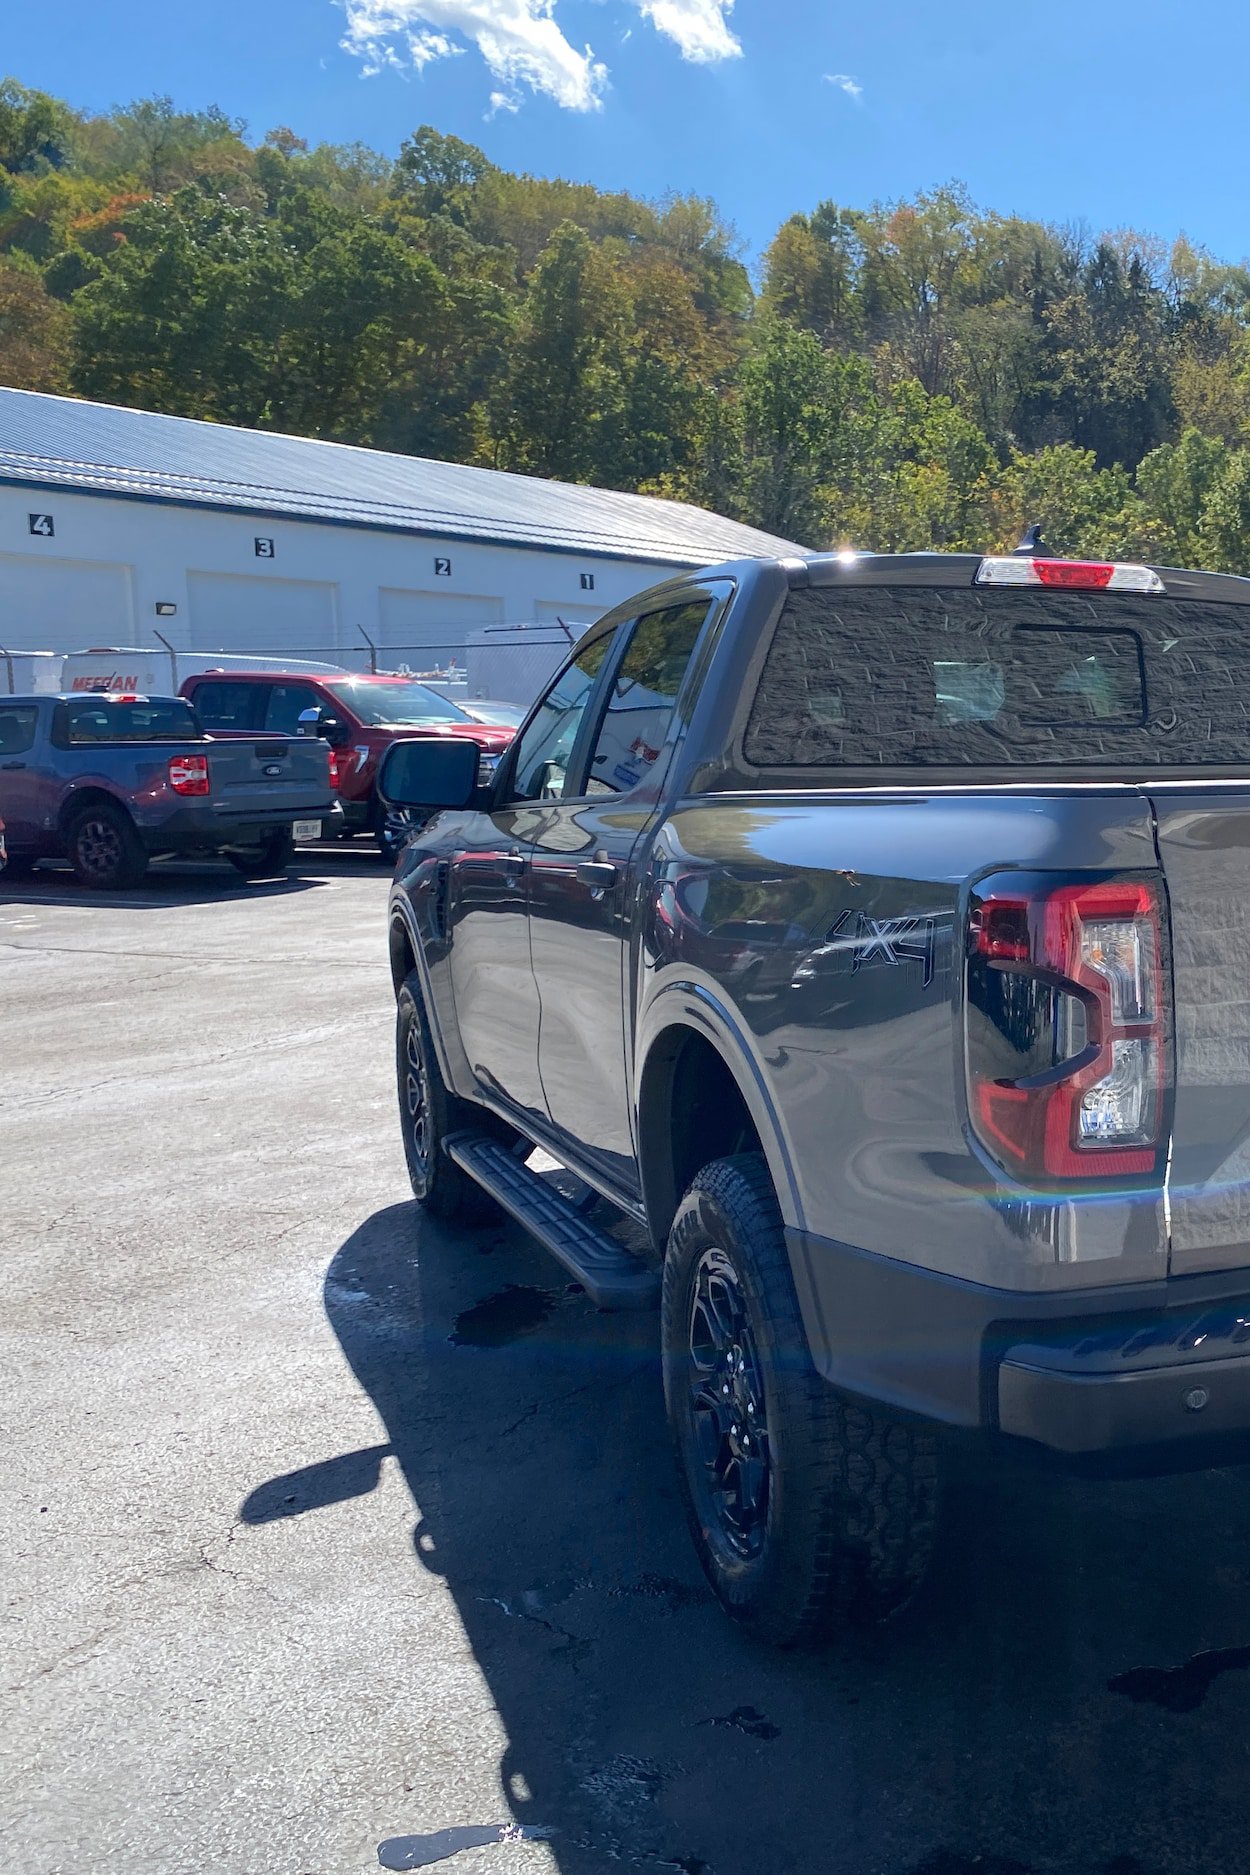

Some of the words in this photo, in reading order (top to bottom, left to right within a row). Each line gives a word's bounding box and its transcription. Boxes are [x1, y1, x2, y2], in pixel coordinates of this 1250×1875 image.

[33, 515, 51, 535] 4
[258, 539, 271, 557] 3
[438, 559, 449, 575] 2
